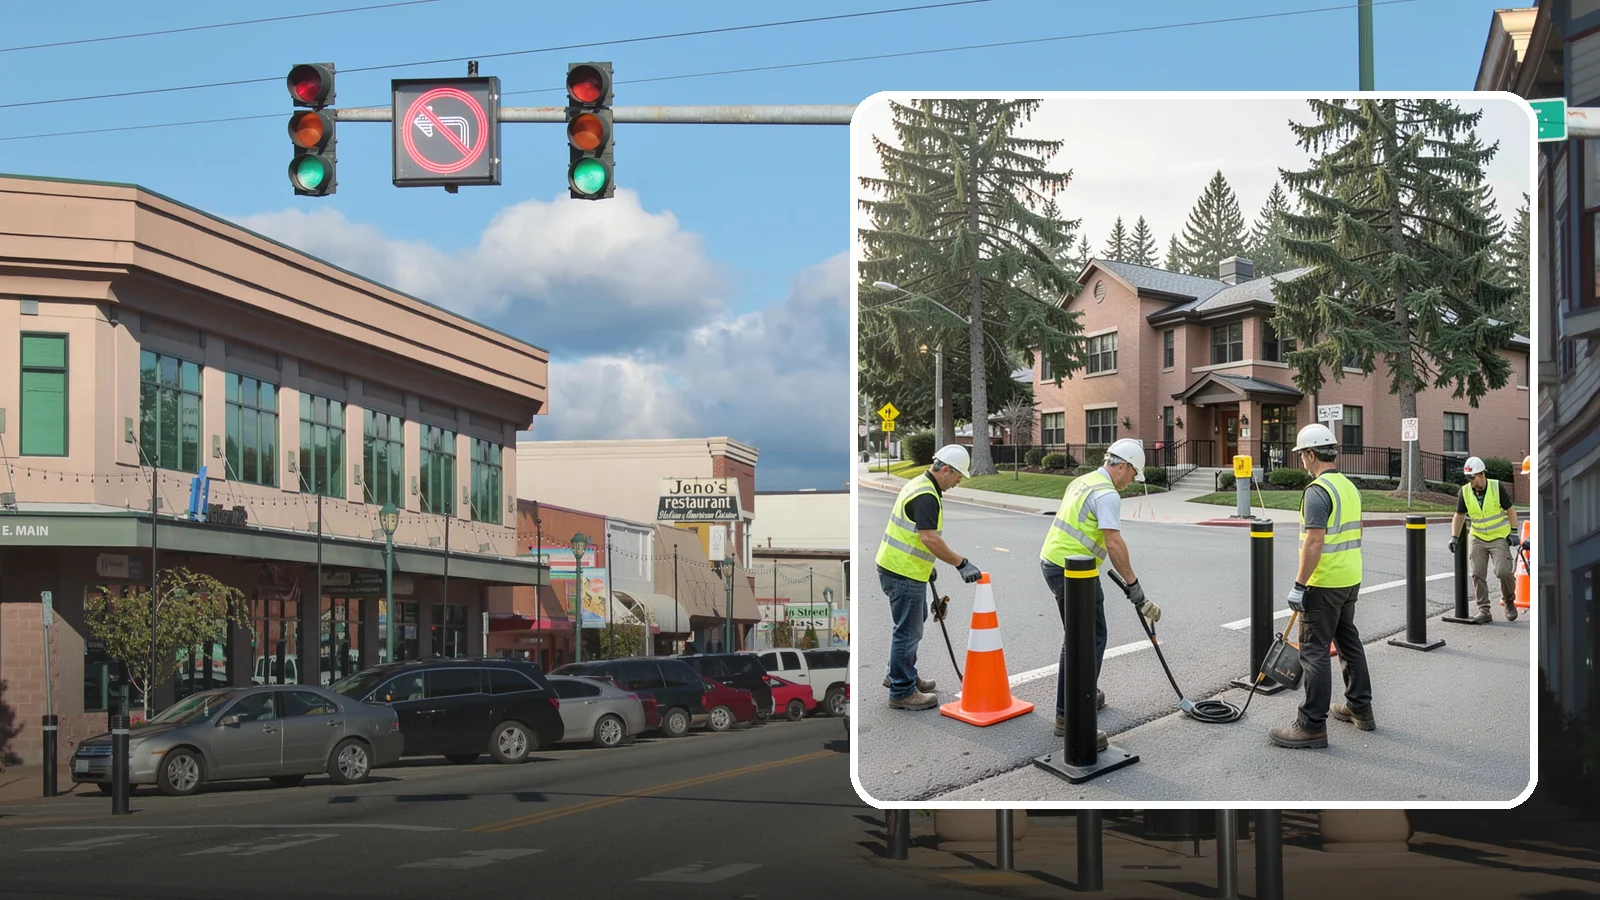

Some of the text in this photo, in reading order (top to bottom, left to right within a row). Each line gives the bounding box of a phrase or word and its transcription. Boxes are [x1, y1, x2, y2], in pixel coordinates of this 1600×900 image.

[670, 480, 727, 494] Jeno's
[665, 496, 731, 509] restaurant
[658, 510, 681, 519] Italian
[686, 510, 714, 519] American
[715, 510, 737, 519] Cuisine
[2, 525, 49, 536] E. MAIN
[785, 607, 828, 617] in Street
